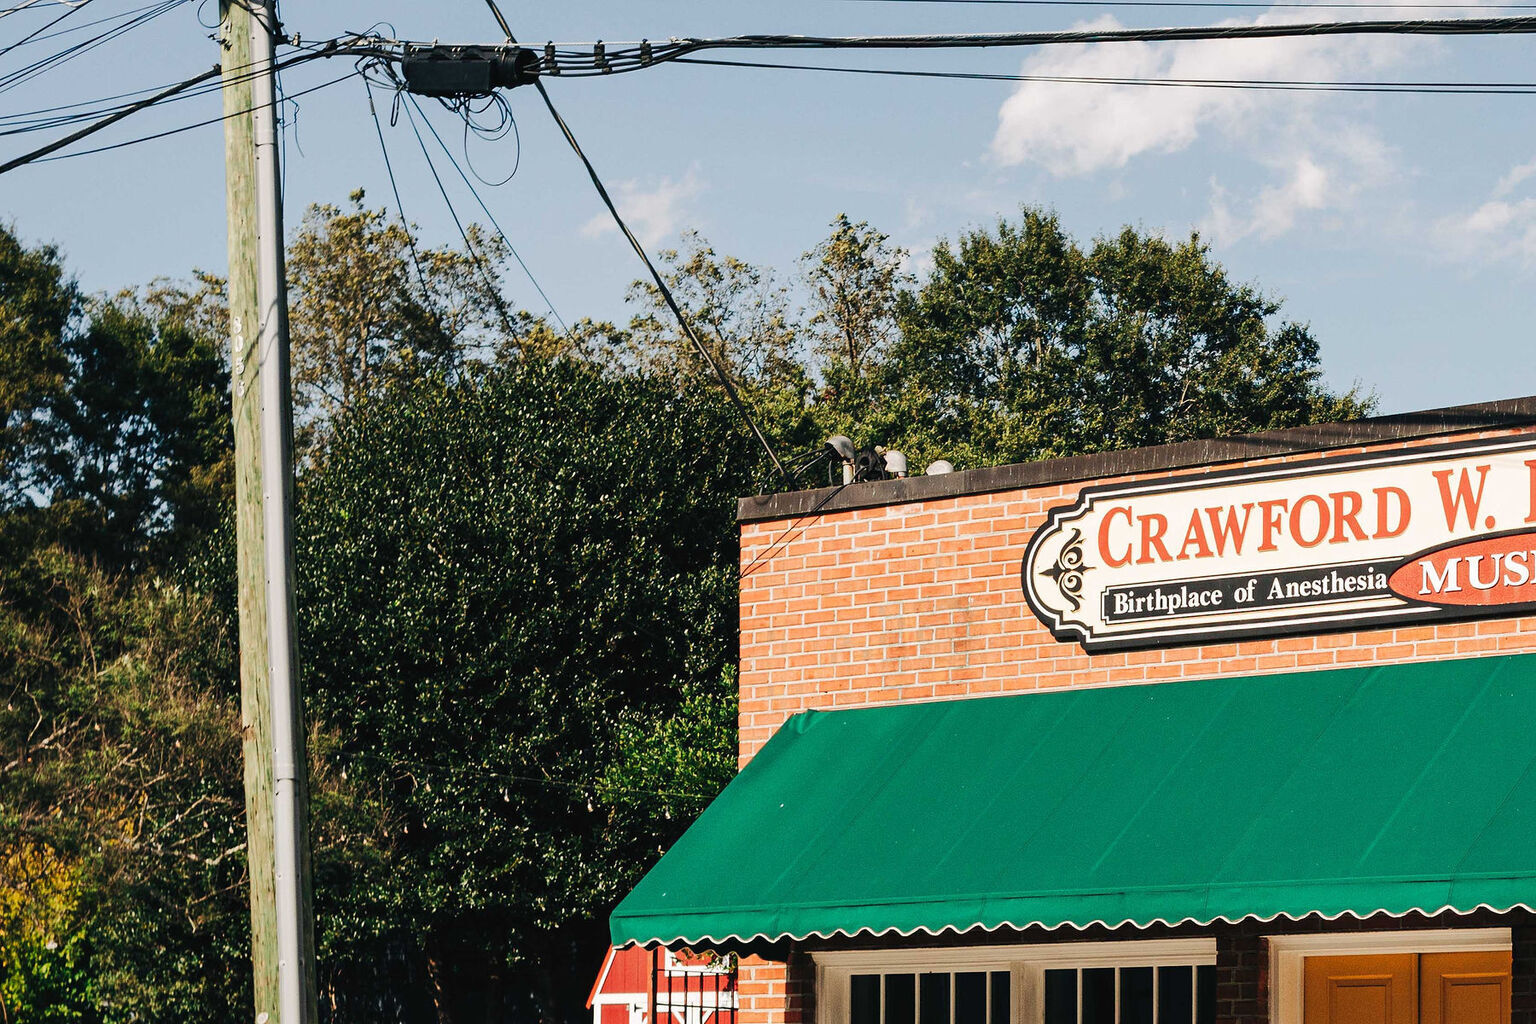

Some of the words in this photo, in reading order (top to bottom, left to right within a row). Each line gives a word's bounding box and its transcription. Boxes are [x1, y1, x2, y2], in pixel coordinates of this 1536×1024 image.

[1097, 485, 1412, 569] CRAWFORD
[1431, 464, 1497, 532] W.
[1112, 578, 1225, 616] Birthplace
[1233, 577, 1257, 607] of
[1266, 566, 1389, 601] Anesthesia
